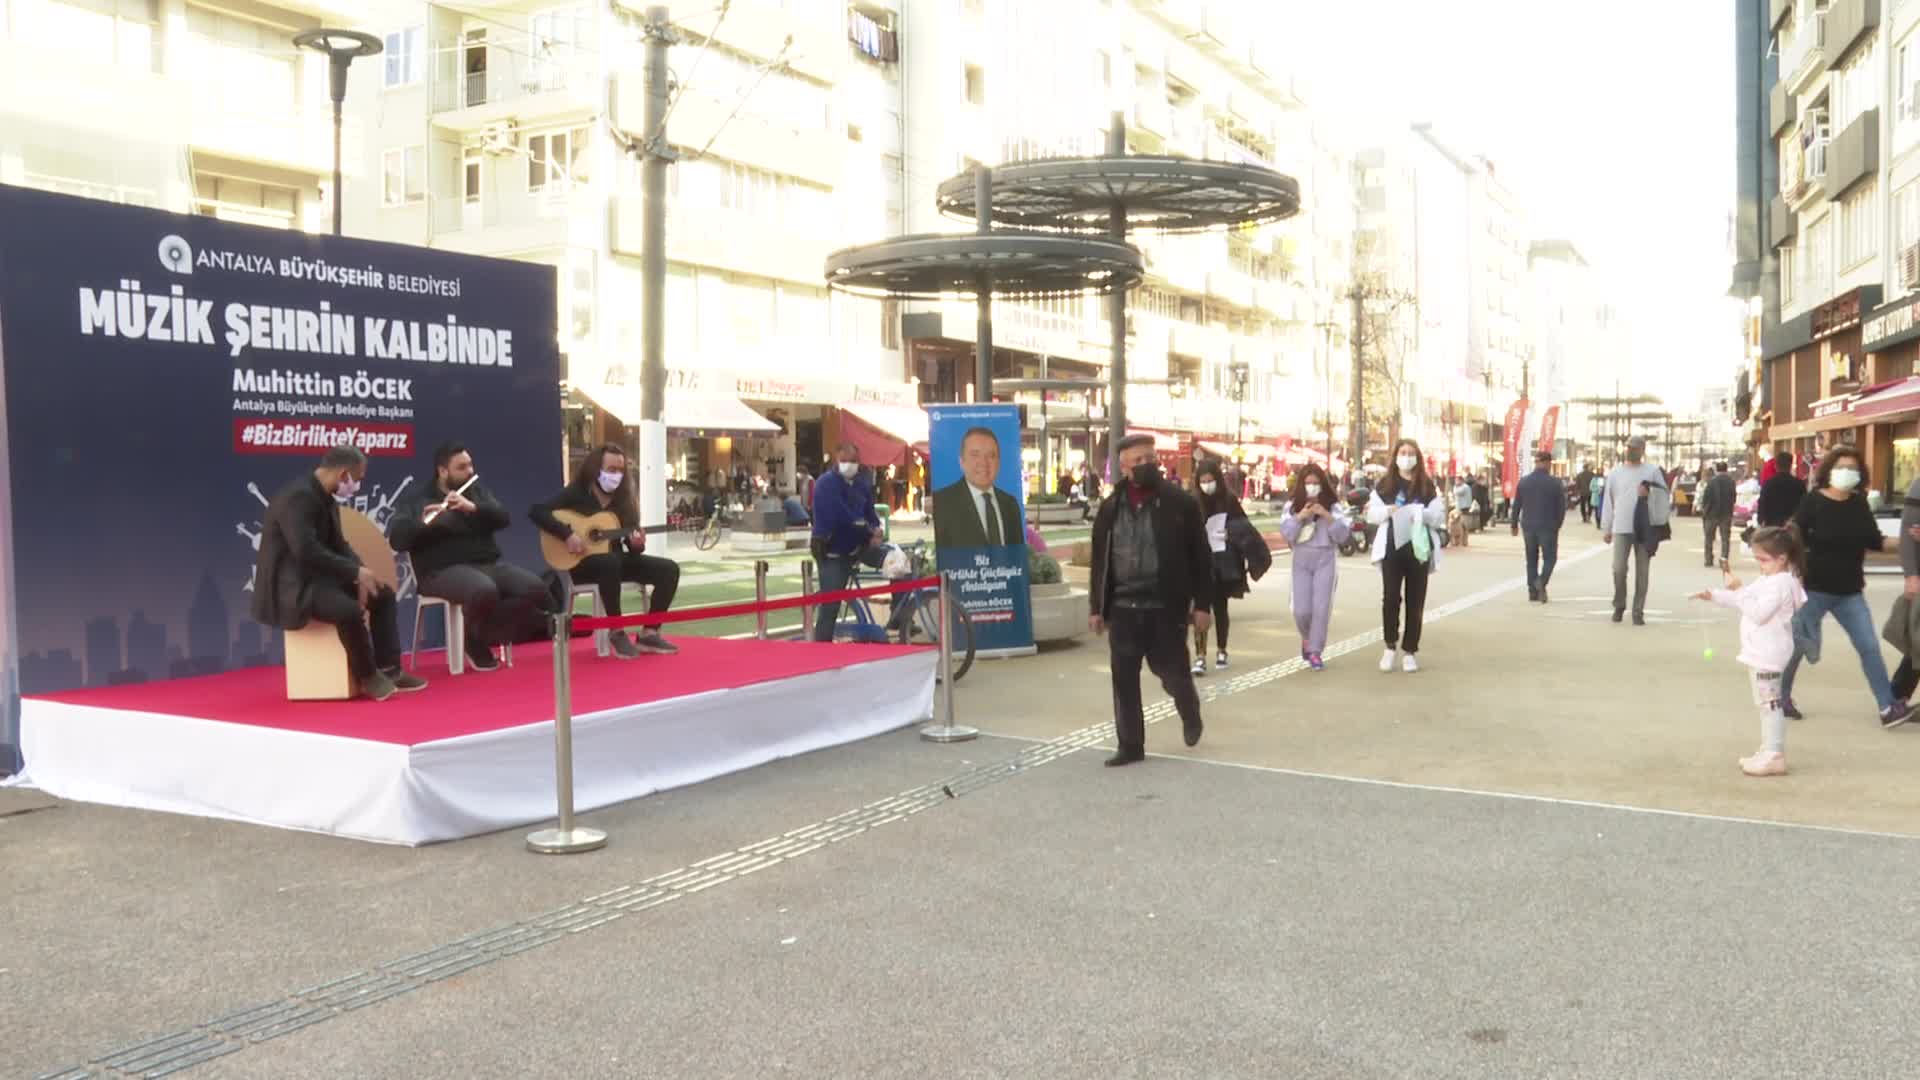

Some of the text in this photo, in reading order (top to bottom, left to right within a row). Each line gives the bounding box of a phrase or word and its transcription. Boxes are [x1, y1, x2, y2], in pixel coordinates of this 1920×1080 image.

[196, 250, 461, 297] ANTALYA BÜYÜKŞEHİR BELEDİYESİ
[79, 278, 513, 367] MÜZİK ŞEHRİN KALBİNDE
[233, 368, 413, 401] Muhittin BÖCEK
[232, 398, 414, 420] Antalya Büyükşehir Belediye Başkanı
[242, 423, 407, 453] #BizBirlikteYaparız
